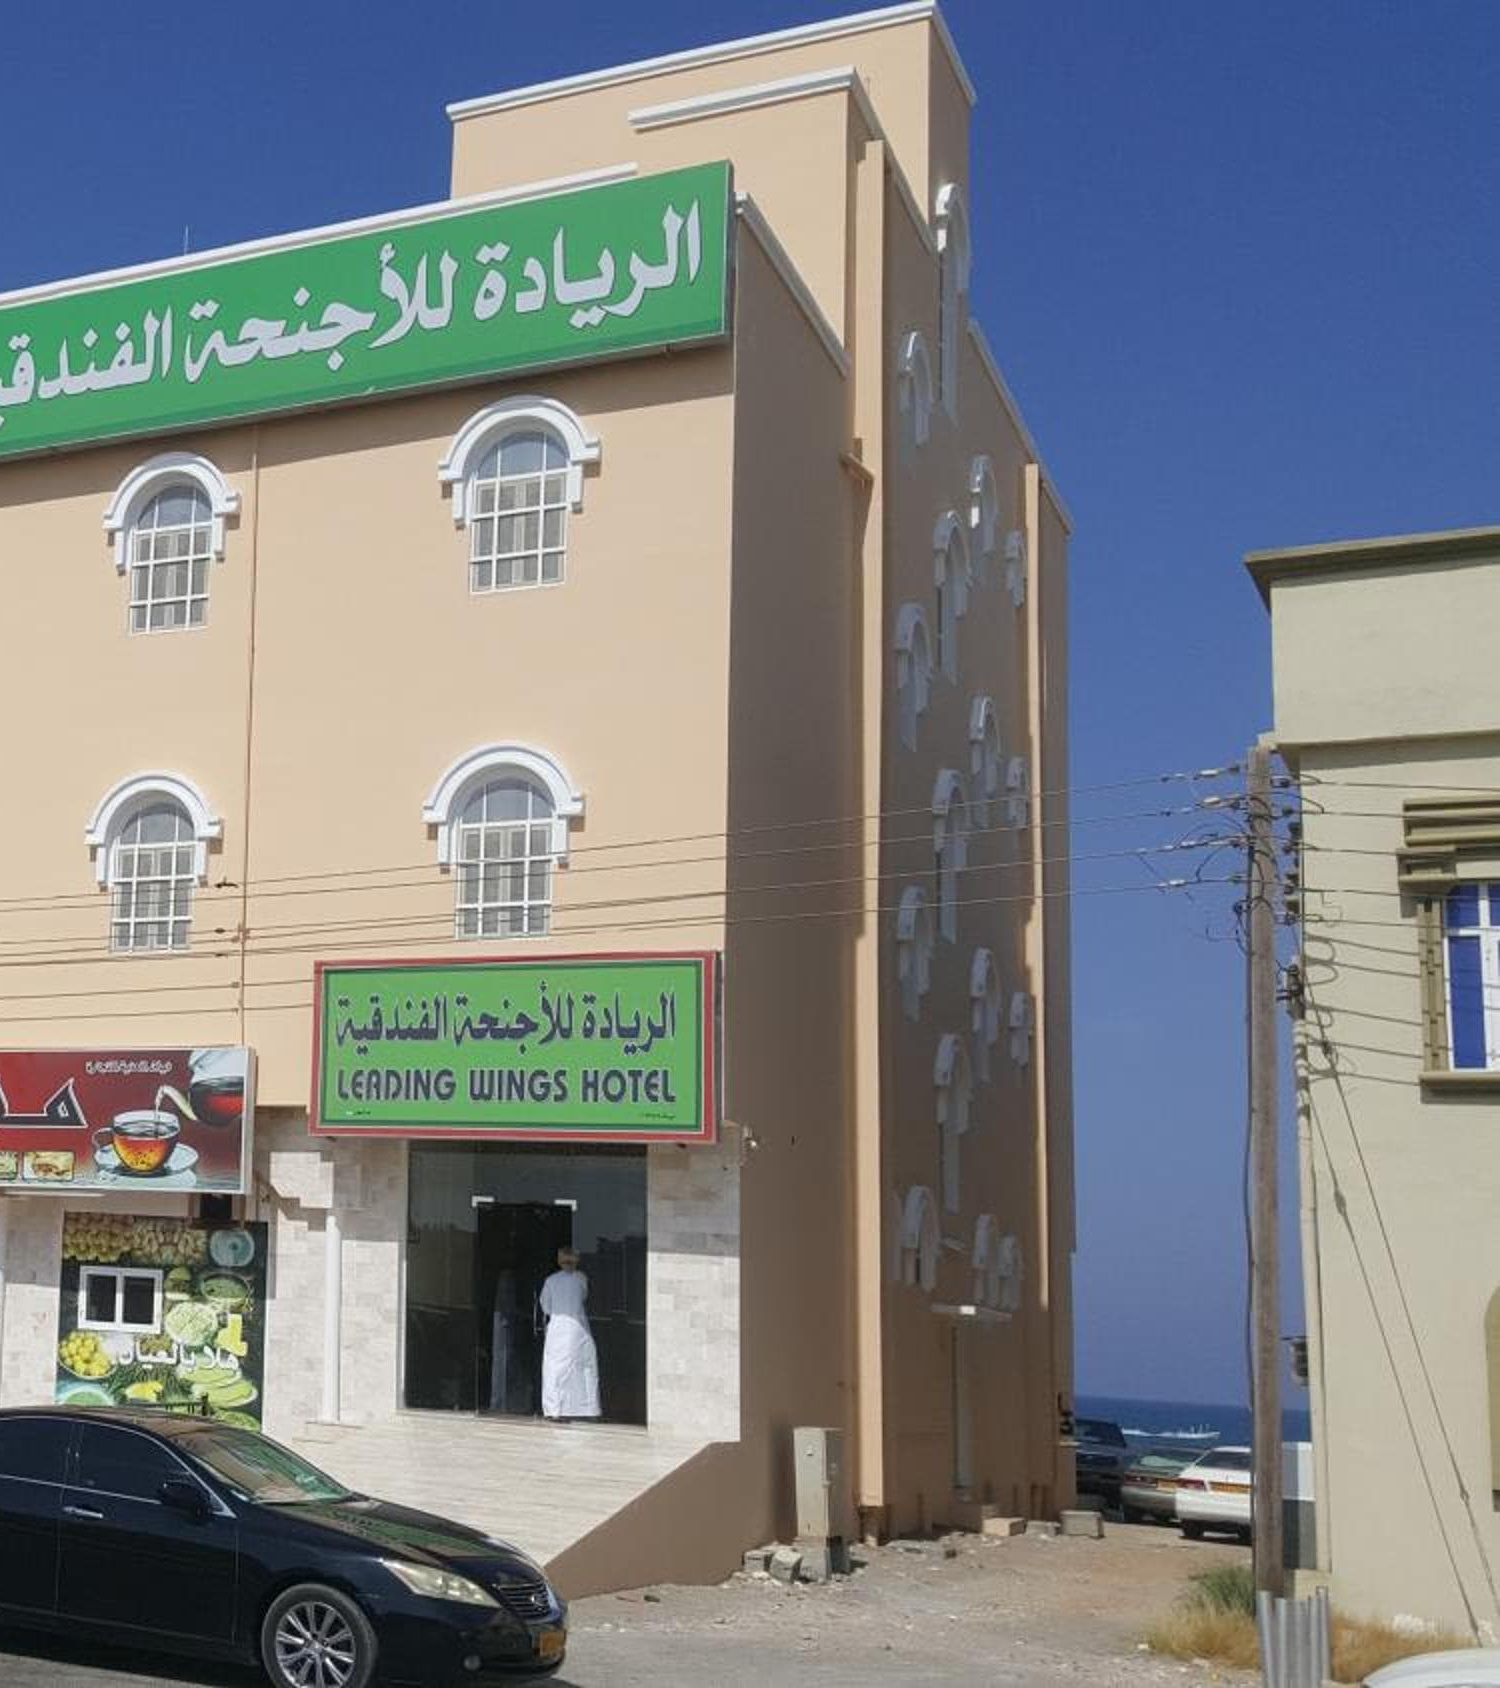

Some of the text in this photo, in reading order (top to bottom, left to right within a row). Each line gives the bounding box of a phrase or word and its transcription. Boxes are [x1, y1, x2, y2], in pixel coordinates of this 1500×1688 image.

[184, 242, 460, 385] للأجنحة
[472, 199, 701, 328] الريادة
[336, 980, 676, 1055] الريادة للأجنحة الفندقية
[337, 1068, 677, 1103] LEADING WINGS HOTEL
